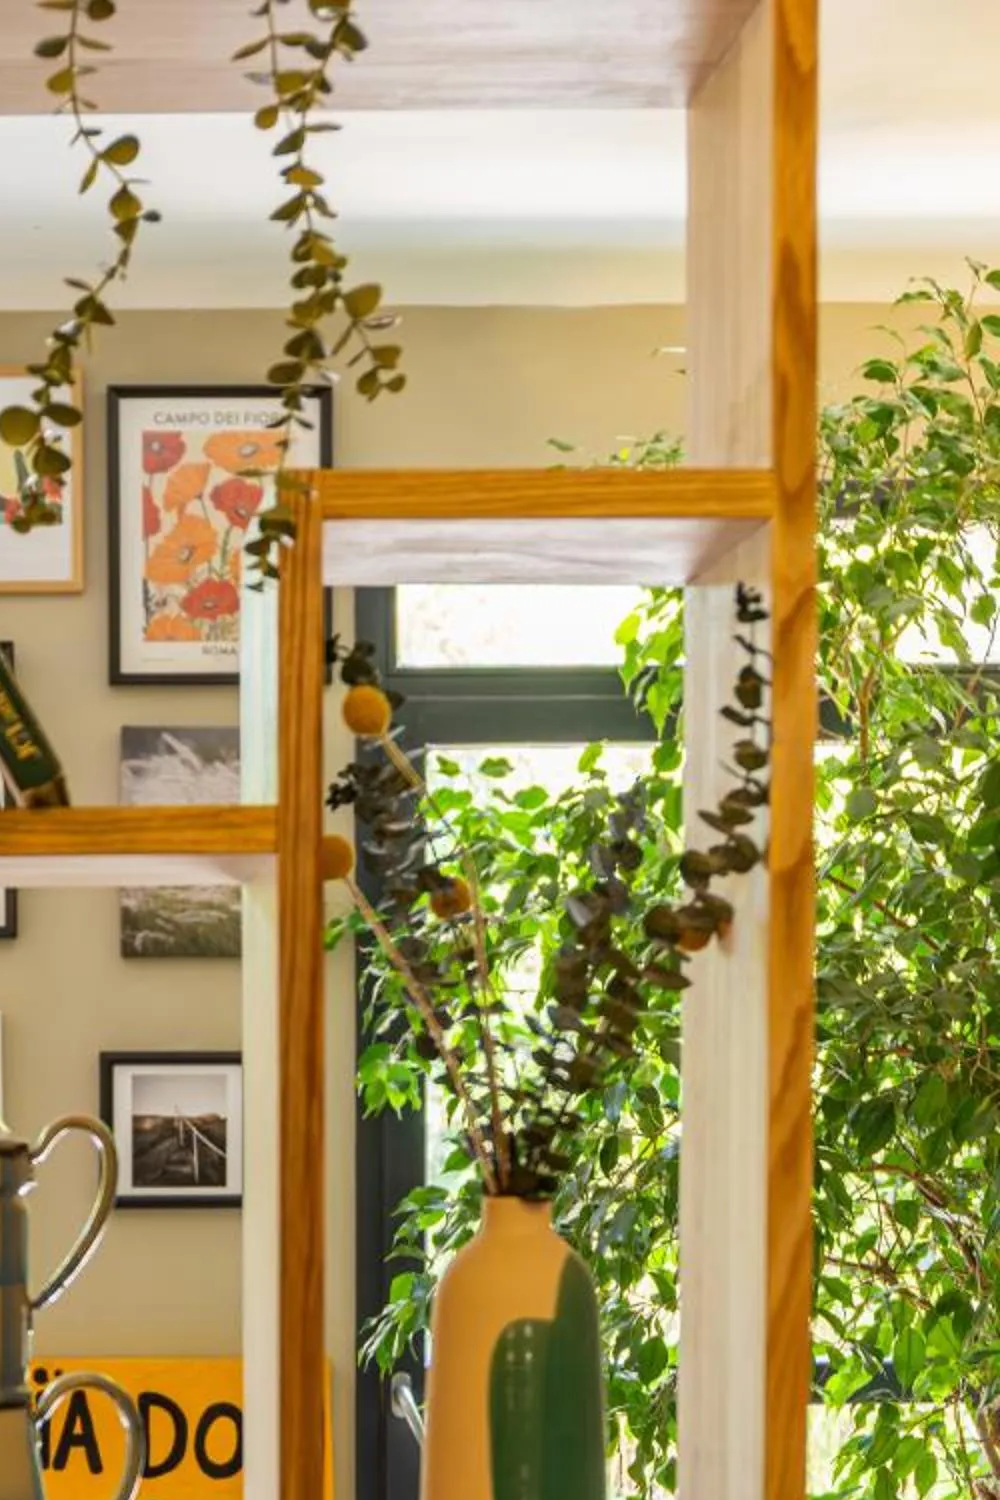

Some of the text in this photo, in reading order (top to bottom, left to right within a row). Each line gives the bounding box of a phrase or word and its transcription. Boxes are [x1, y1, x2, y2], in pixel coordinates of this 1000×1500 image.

[152, 411, 285, 426] CAMPO DEI FIOR
